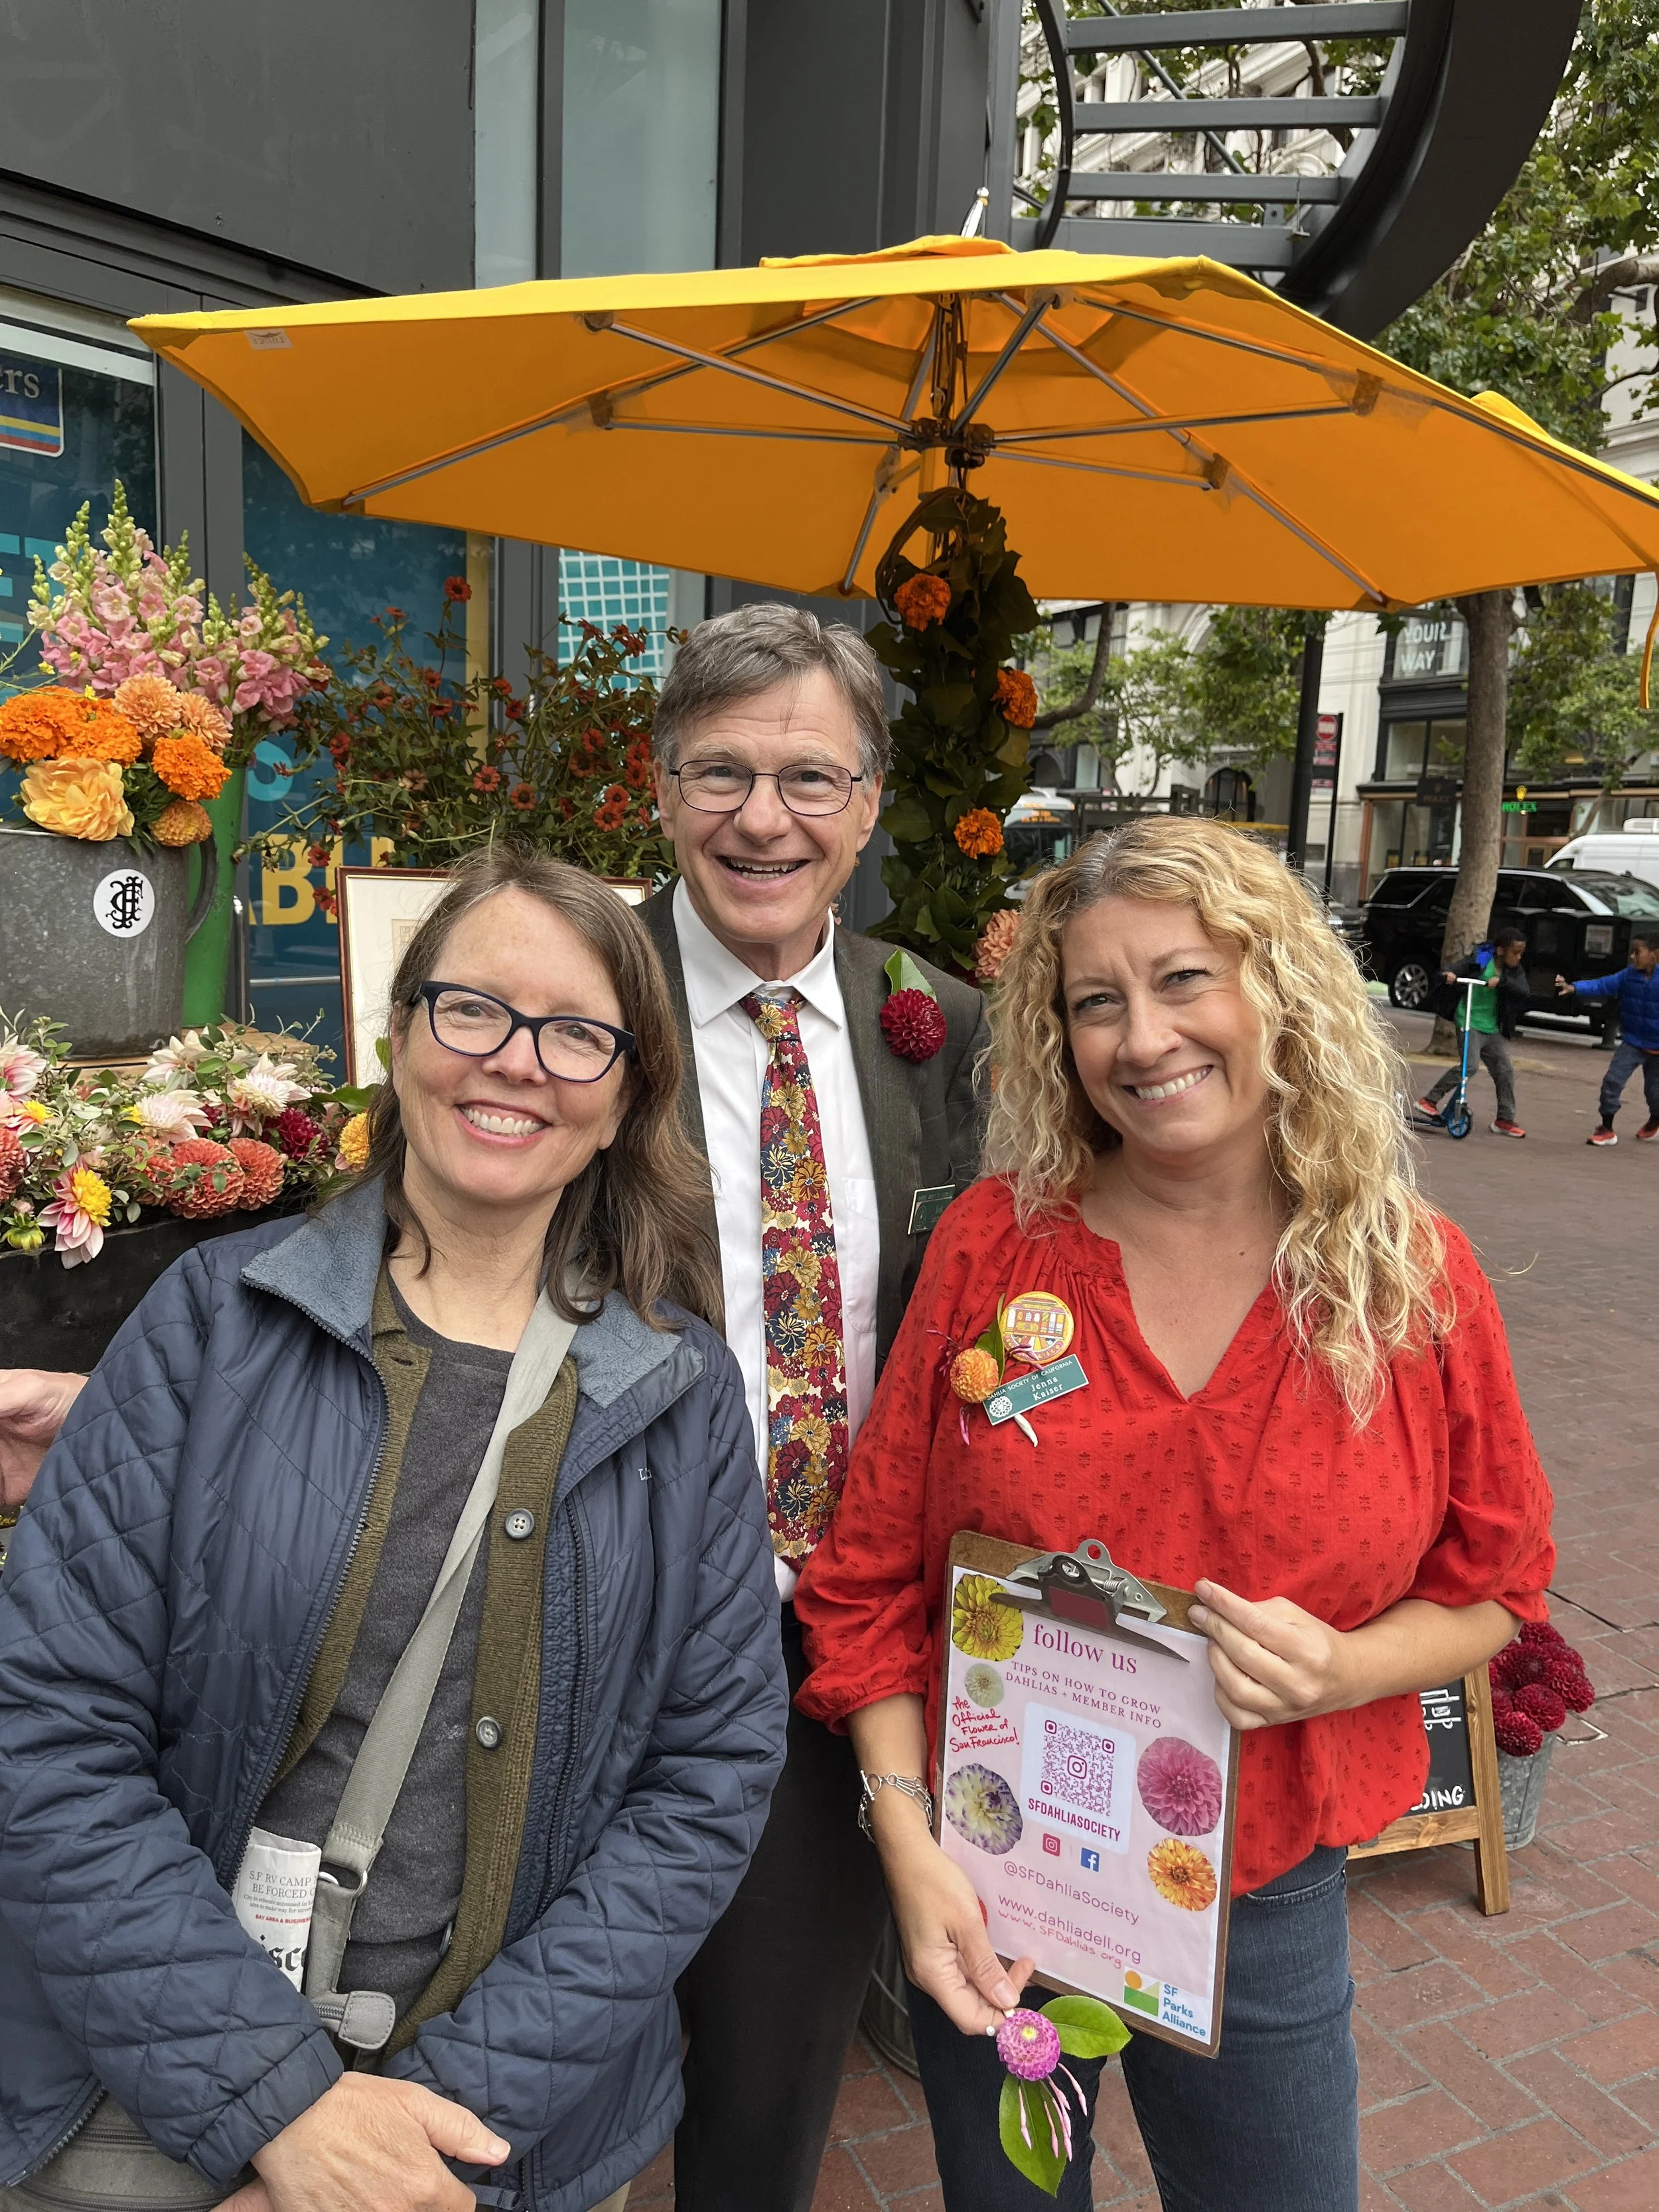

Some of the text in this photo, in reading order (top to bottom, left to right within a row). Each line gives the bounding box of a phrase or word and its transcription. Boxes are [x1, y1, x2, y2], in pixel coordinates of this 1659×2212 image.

[0, 368, 40, 399] rs
[1401, 650, 1436, 672] WAY
[1007, 1378, 1029, 1391] SOCIETY
[1041, 1361, 1073, 1376] CALIFORNIA
[1031, 1376, 1058, 1392] Jenna
[1032, 1384, 1063, 1401] Kaiser
[1033, 1623, 1137, 1674] follow us
[1011, 1661, 1161, 1714] TIPS ON HOW TO GROW
[1006, 1672, 1058, 1695] DAHLIAS
[1072, 1692, 1125, 1718] MEMBER
[1130, 1711, 1161, 1728] INFO
[952, 1708, 1001, 1726] Official
[999, 1718, 1008, 1730] of
[1028, 1798, 1121, 1842] SFDAHLIASOCIETY
[249, 1870, 263, 1881] S.F.
[265, 1874, 277, 1883] RV
[279, 1877, 311, 1887] CAMP
[252, 1883, 264, 1893] BE
[265, 1885, 307, 1898] FORCED
[1004, 1861, 1139, 1925] @SFDahliaSociety
[999, 1895, 1141, 1964] www.dahliadell.org
[1164, 1984, 1178, 1996] SF
[1163, 1997, 1193, 2018] Parks
[1162, 2011, 1206, 2036] Alliance
